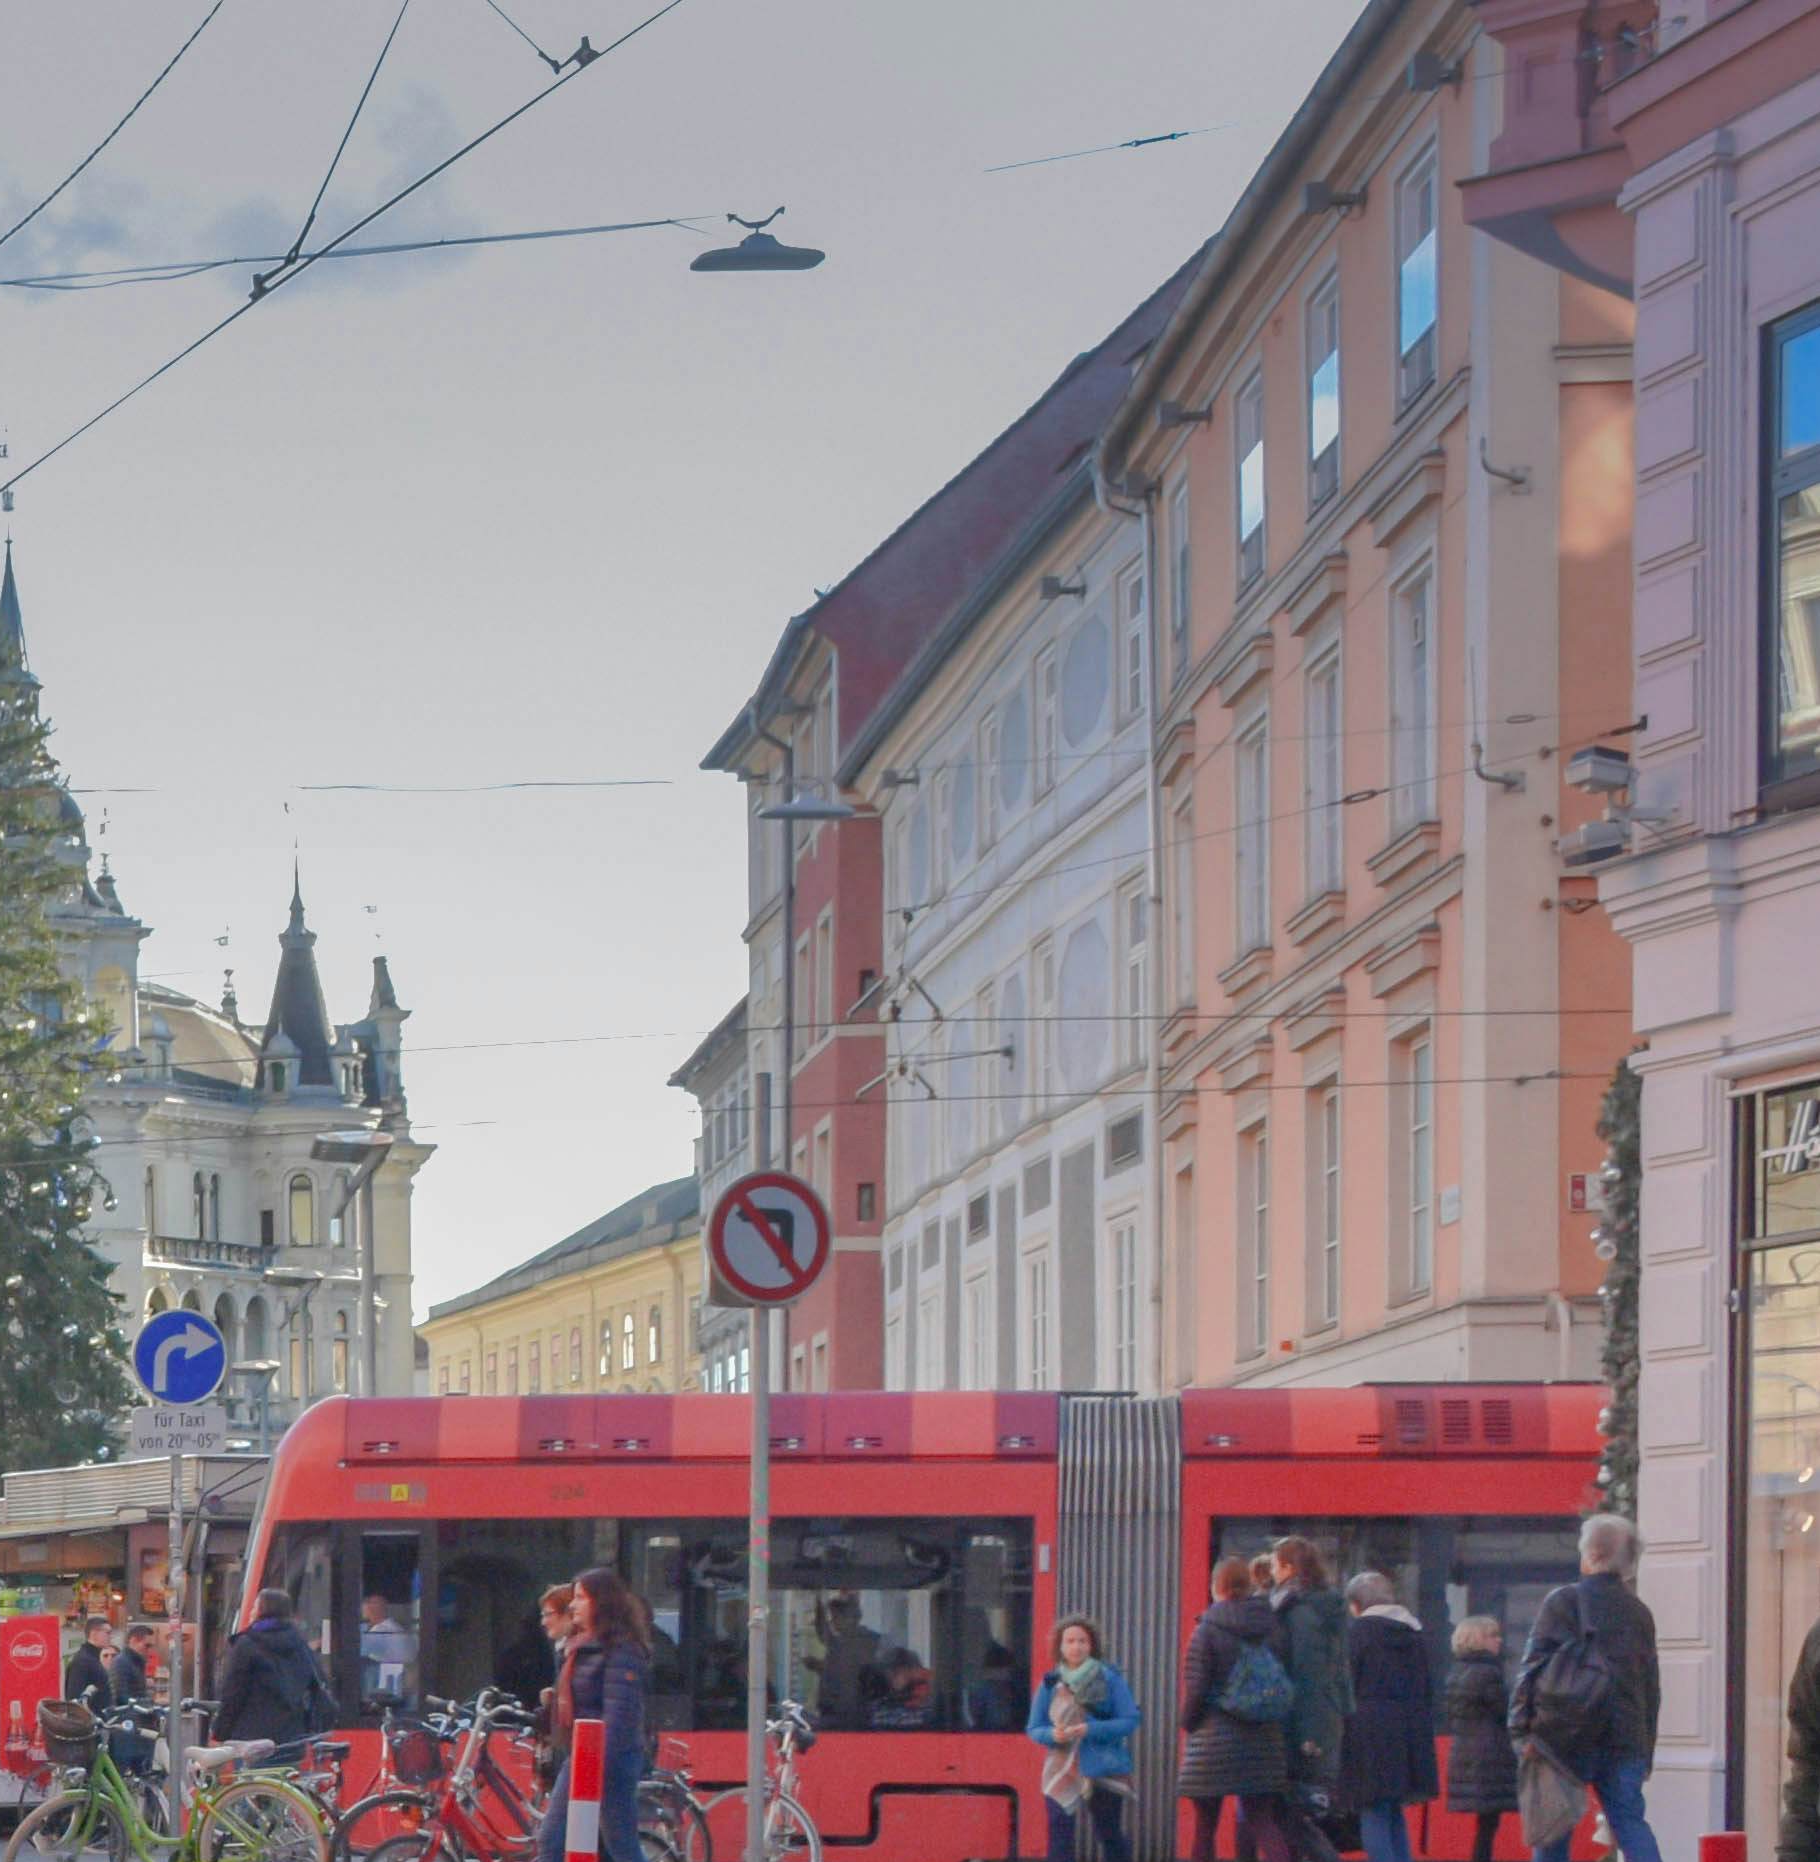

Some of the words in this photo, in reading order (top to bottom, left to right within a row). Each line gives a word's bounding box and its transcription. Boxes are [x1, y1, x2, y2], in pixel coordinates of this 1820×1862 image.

[153, 1411, 173, 1428] für
[178, 1411, 206, 1428] Taxi
[138, 1436, 164, 1449] von
